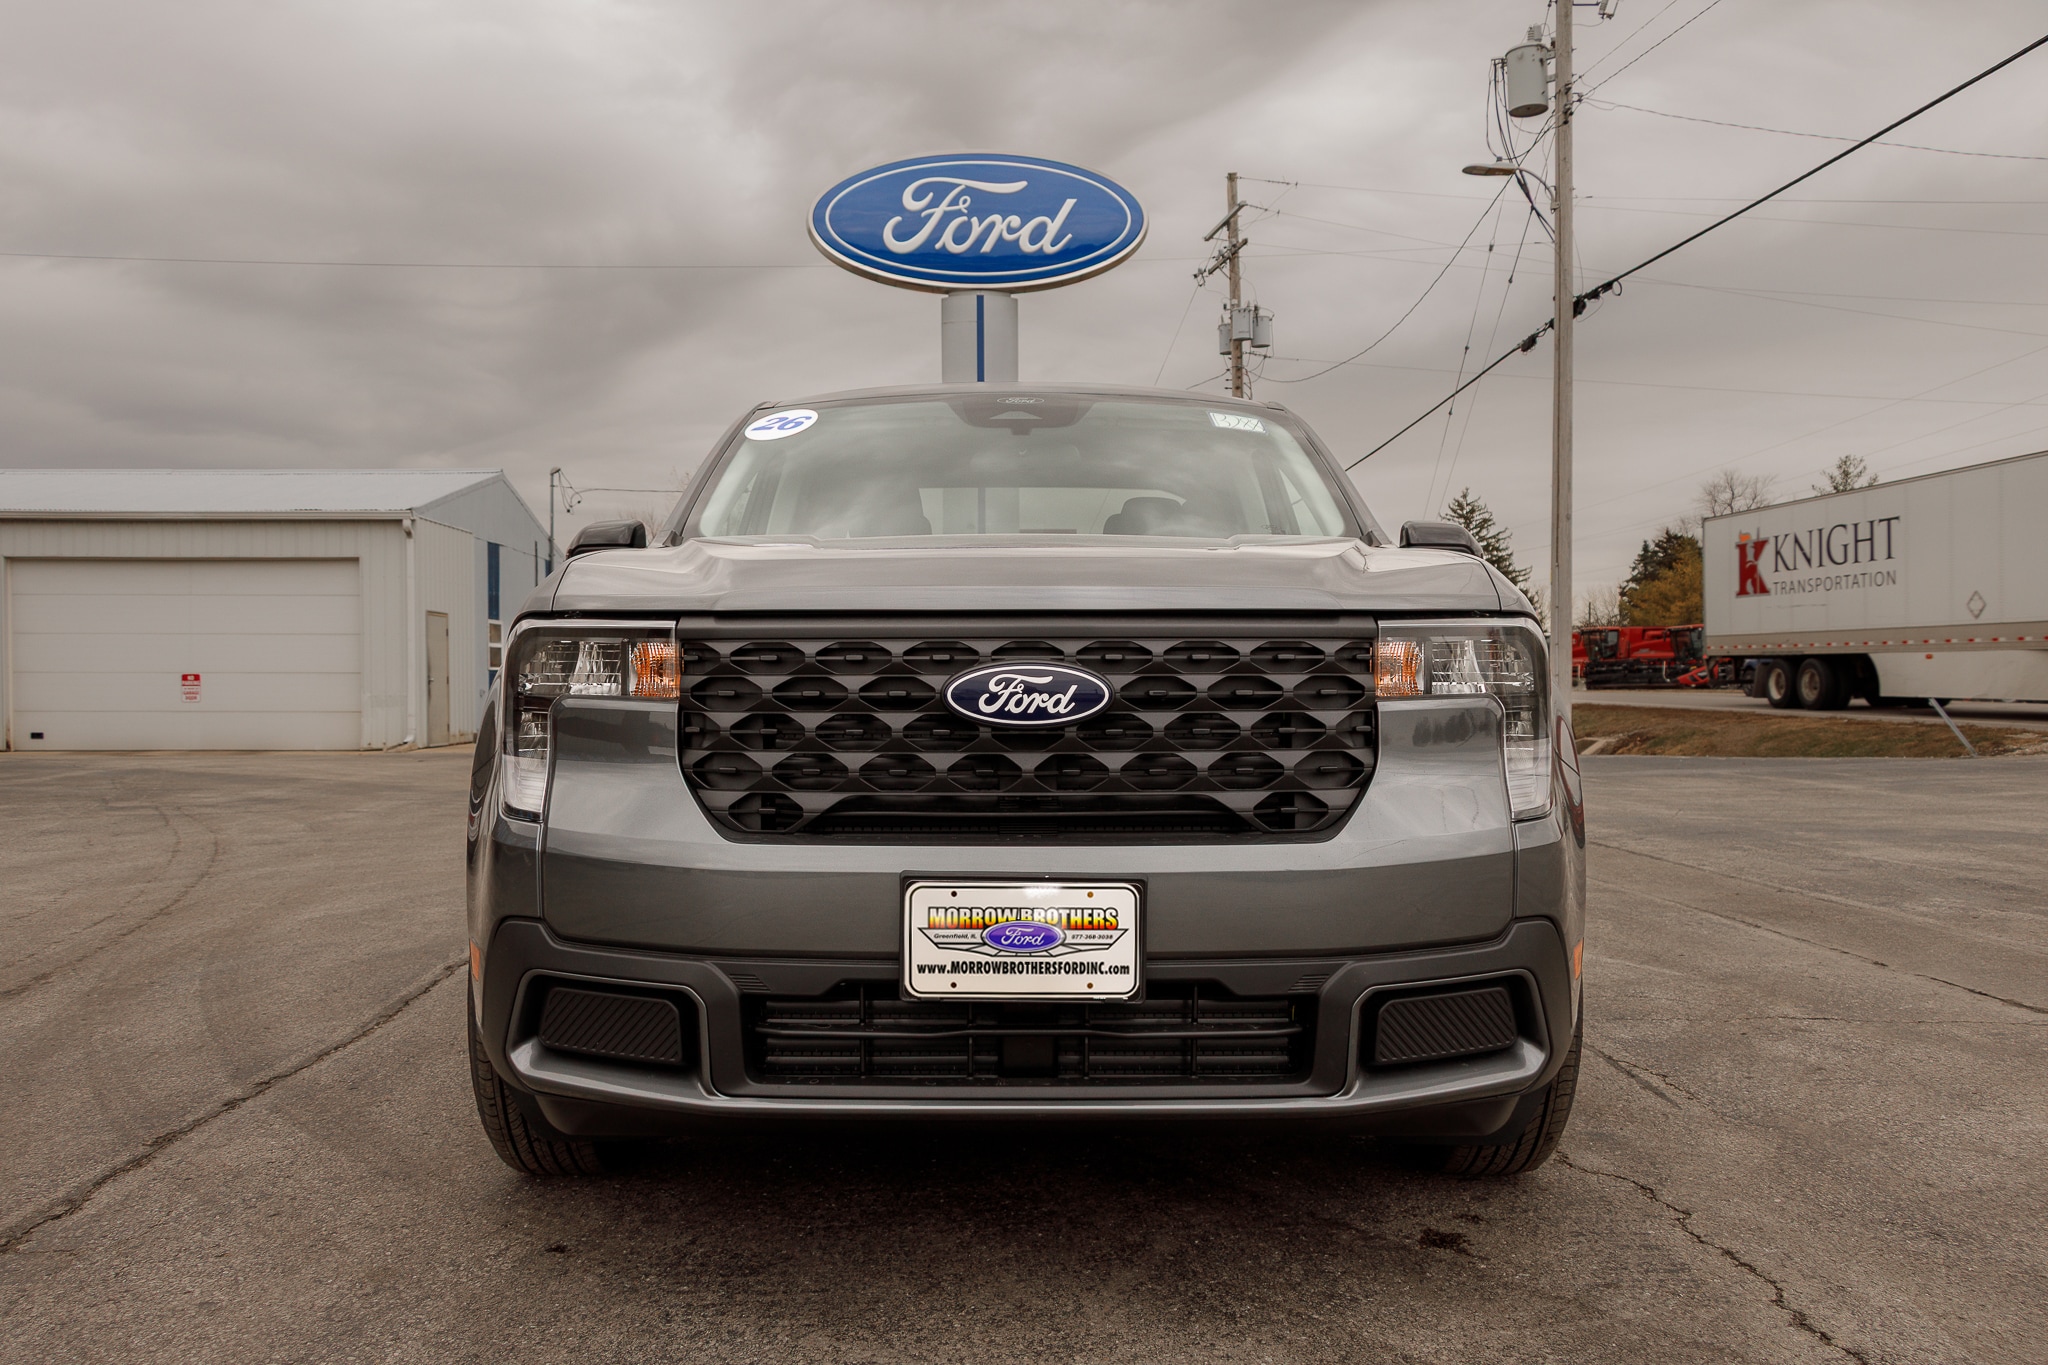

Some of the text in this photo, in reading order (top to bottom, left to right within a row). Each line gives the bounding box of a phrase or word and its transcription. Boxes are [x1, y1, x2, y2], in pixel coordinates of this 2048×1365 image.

[883, 176, 1077, 254] Ford
[751, 416, 812, 431] 26
[1773, 516, 1900, 573] KNIGHT
[1773, 570, 1897, 595] TRANSPORTATION
[978, 673, 1078, 714] Ford
[1001, 926, 1045, 945] Ford
[916, 960, 1130, 975] www.MORROWBROTHERSFORDINC.com
